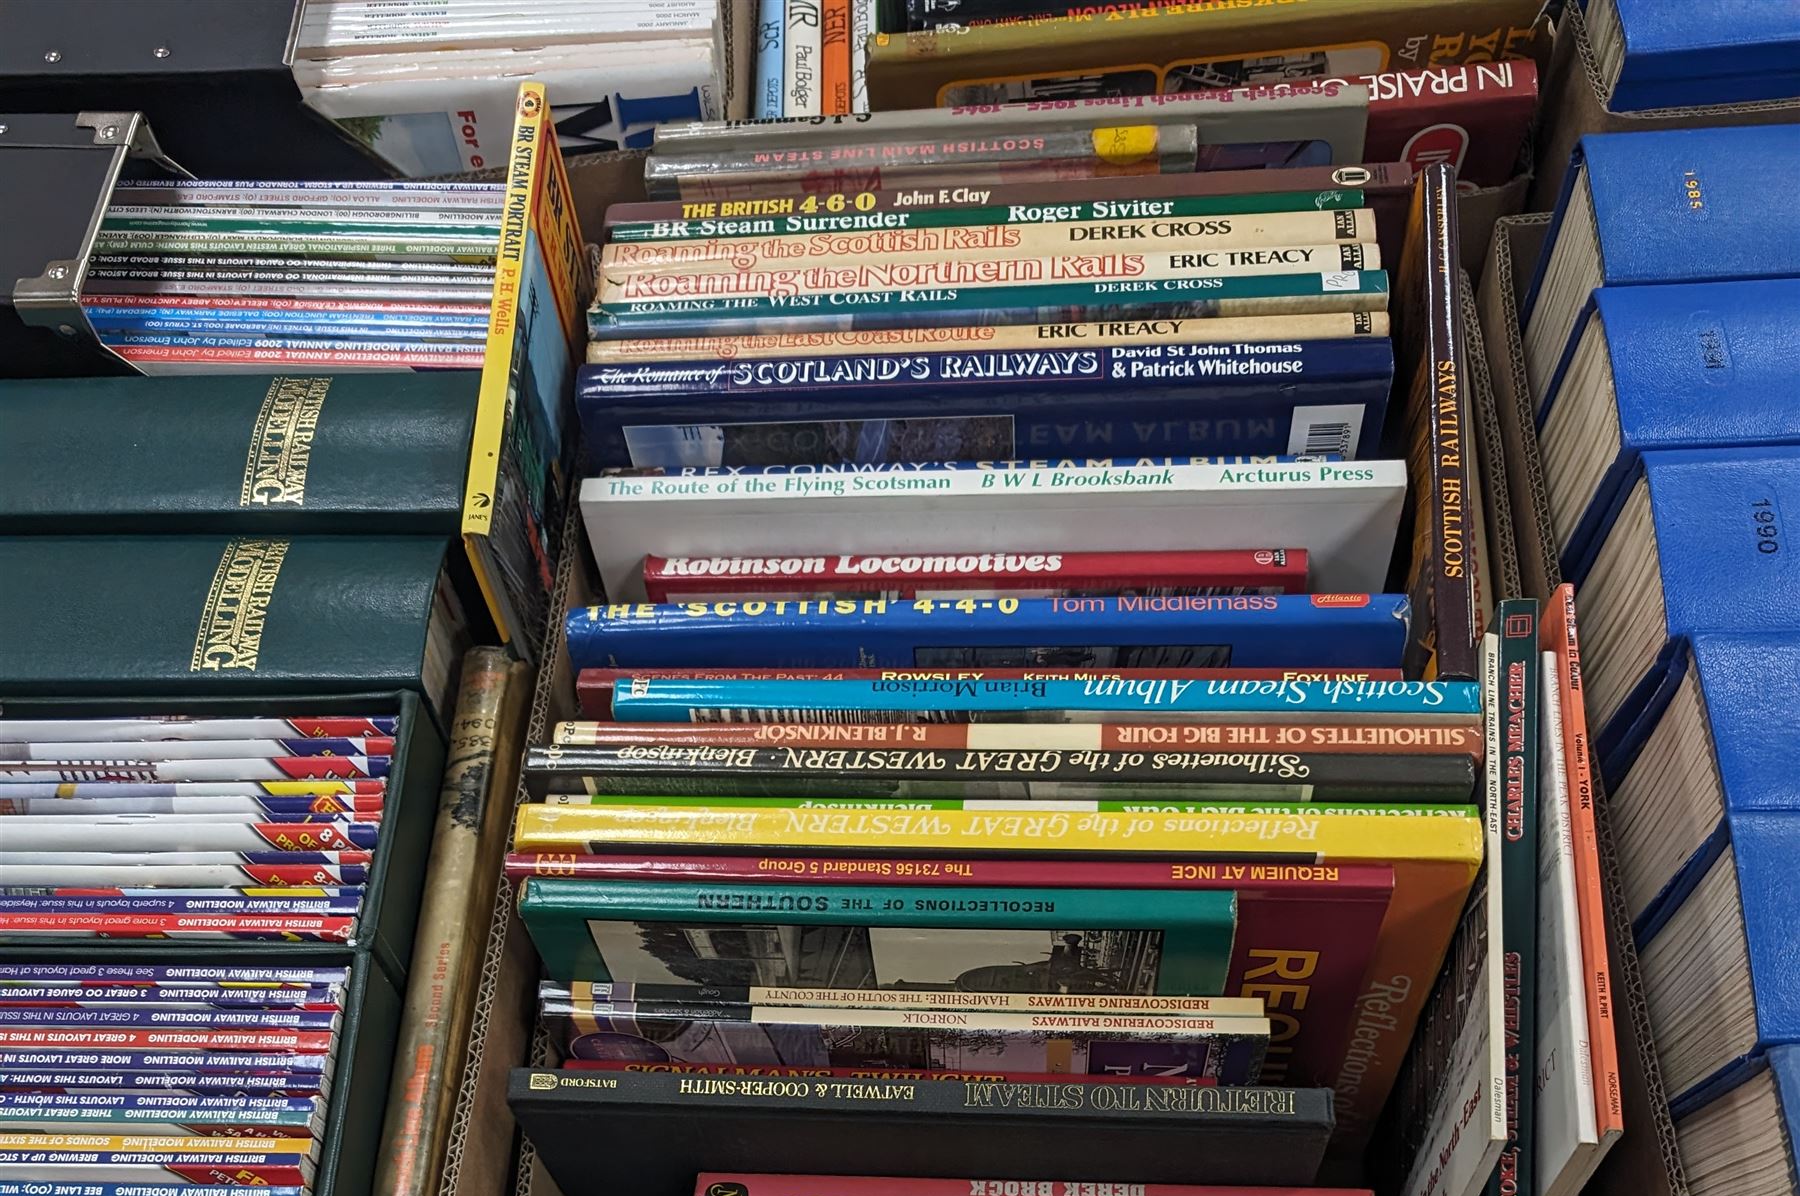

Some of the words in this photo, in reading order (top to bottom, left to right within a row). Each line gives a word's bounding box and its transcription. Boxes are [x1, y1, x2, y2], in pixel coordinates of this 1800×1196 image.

[825, 6, 845, 45] NER
[796, 44, 812, 71] Paul
[517, 125, 534, 143] BR
[831, 148, 875, 159] LINE
[882, 144, 934, 156] MAIN
[944, 139, 1044, 153] SCOTTISH
[754, 152, 822, 162] STEAM
[512, 146, 531, 192] STEAM
[1685, 171, 1702, 209] 1985
[682, 202, 715, 218] THE
[720, 199, 793, 216] BRITISH
[799, 192, 876, 213] 4-6-0
[894, 191, 935, 206] John
[952, 188, 990, 205] Clay
[652, 222, 687, 238] BR
[700, 217, 775, 236] Steam
[786, 212, 909, 231] Surrender
[1007, 202, 1081, 223] Roger
[1092, 199, 1173, 218] Siviter
[503, 194, 525, 261] PORTRAIT
[614, 241, 759, 269] Roaming
[760, 237, 805, 259] the
[809, 230, 938, 255] Scottish
[944, 225, 1020, 249] Rails
[1069, 225, 1146, 241] DEREK
[1151, 220, 1231, 238] CROSS
[1169, 254, 1219, 268] ERIC
[1224, 249, 1313, 266] TREACY
[495, 299, 513, 335] Wells
[125, 335, 170, 344] Emerson
[174, 336, 200, 344] John
[203, 337, 213, 345] by
[255, 340, 282, 348] 2009
[286, 339, 330, 349] ANNUAL
[1112, 347, 1163, 359] David
[1189, 344, 1227, 356] John
[1231, 343, 1302, 354] Thomas
[732, 354, 930, 385] SCOTLAND'S
[939, 352, 1098, 380] RAILWAYS
[1131, 360, 1194, 377] Patrick
[1198, 358, 1303, 375] Whitehouse
[1443, 360, 1458, 468] RAILWAYS
[608, 481, 643, 496] The
[651, 480, 709, 495] Route
[717, 478, 739, 493] of
[745, 477, 776, 492] the
[784, 477, 845, 496] Flying
[853, 475, 951, 491] Scotsman
[1051, 469, 1175, 486] Brooksbank
[1220, 467, 1311, 482] Arcturus
[1320, 466, 1373, 480] Press
[1444, 478, 1465, 578] SCOTTISH
[1751, 496, 1778, 555] 1990
[1508, 661, 1525, 752] MEACHER
[1117, 726, 1178, 743] FOUR
[1183, 726, 1220, 743] BIG
[1227, 727, 1270, 743] THE
[1276, 727, 1307, 744] OF
[1313, 727, 1465, 744] SILHOUETTES
[1489, 745, 1495, 755] IN
[1506, 756, 1524, 841] CHARLES
[1579, 780, 1590, 809] YORK
[759, 858, 805, 873] Group
[822, 860, 890, 874] Standard
[894, 862, 940, 876] 73156
[944, 864, 973, 875] The
[1172, 865, 1217, 879] INCE
[1222, 866, 1247, 879] AT
[1251, 866, 1339, 881] REQUIEM
[433, 943, 450, 980] Series
[425, 984, 443, 1028] Second
[902, 1014, 967, 1025] NORFOLK
[1033, 1017, 1098, 1027] RAILWAYS
[1102, 1019, 1214, 1029] REDISCOVERING
[47, 1032, 90, 1042] LAYOUTS
[90, 1033, 127, 1042] GREAT
[149, 1034, 208, 1043] MODELLING
[212, 1034, 259, 1044] RAILWAY
[262, 1035, 297, 1045] BRITISH
[560, 1077, 617, 1089] BATSFORD
[680, 1079, 809, 1097] COOPER-SMITH
[831, 1083, 914, 1099] EATWELL
[1608, 1072, 1620, 1115] NORSEMAN
[56, 1185, 79, 1195] LANE
[81, 1186, 102, 1196] BEE
[116, 1188, 174, 1196] MODELLING
